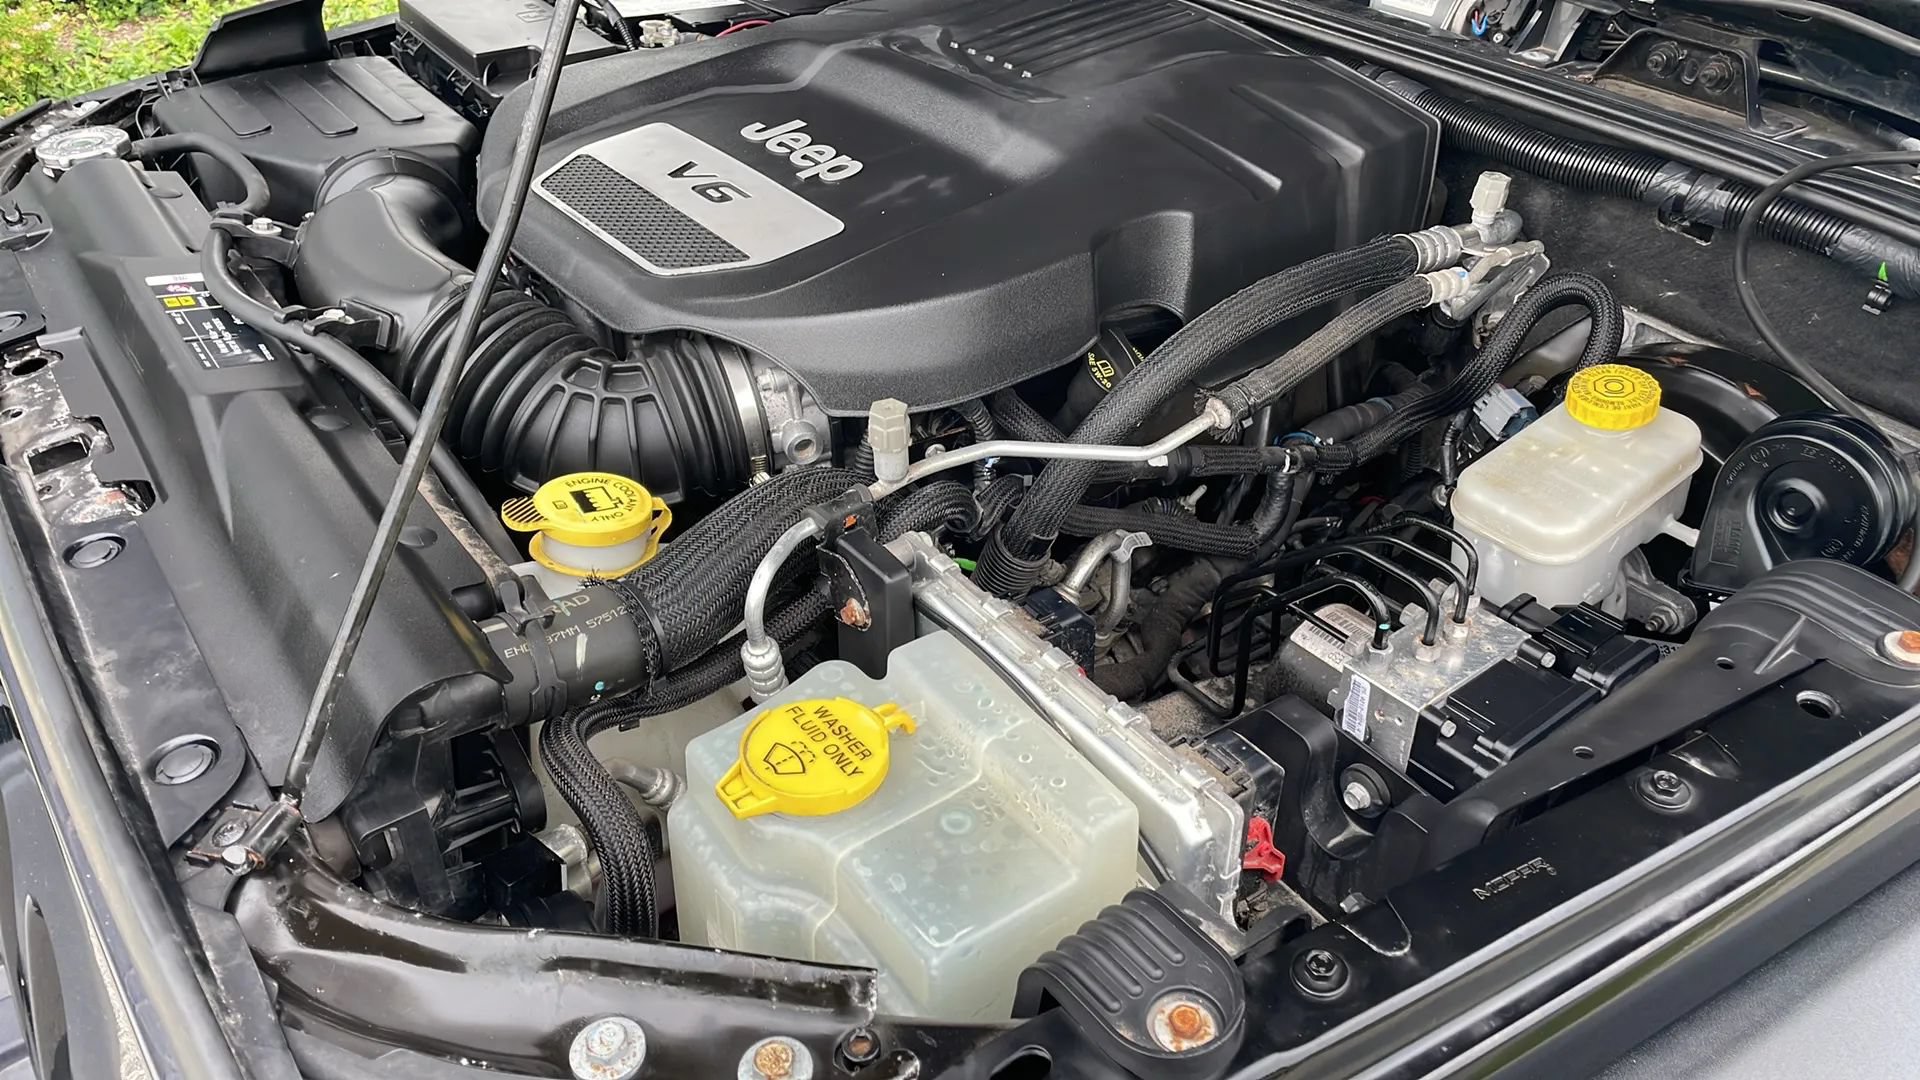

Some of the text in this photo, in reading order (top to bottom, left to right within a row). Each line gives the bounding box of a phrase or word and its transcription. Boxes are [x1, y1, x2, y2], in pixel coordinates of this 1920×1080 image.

[740, 119, 863, 182] Jeep
[667, 161, 752, 203] V6
[565, 477, 638, 522] ENGINE COOLANT ONLY
[785, 705, 864, 777] FLUID ONLY
[813, 705, 872, 761] WASHER
[1472, 857, 1549, 900] MOPAR
